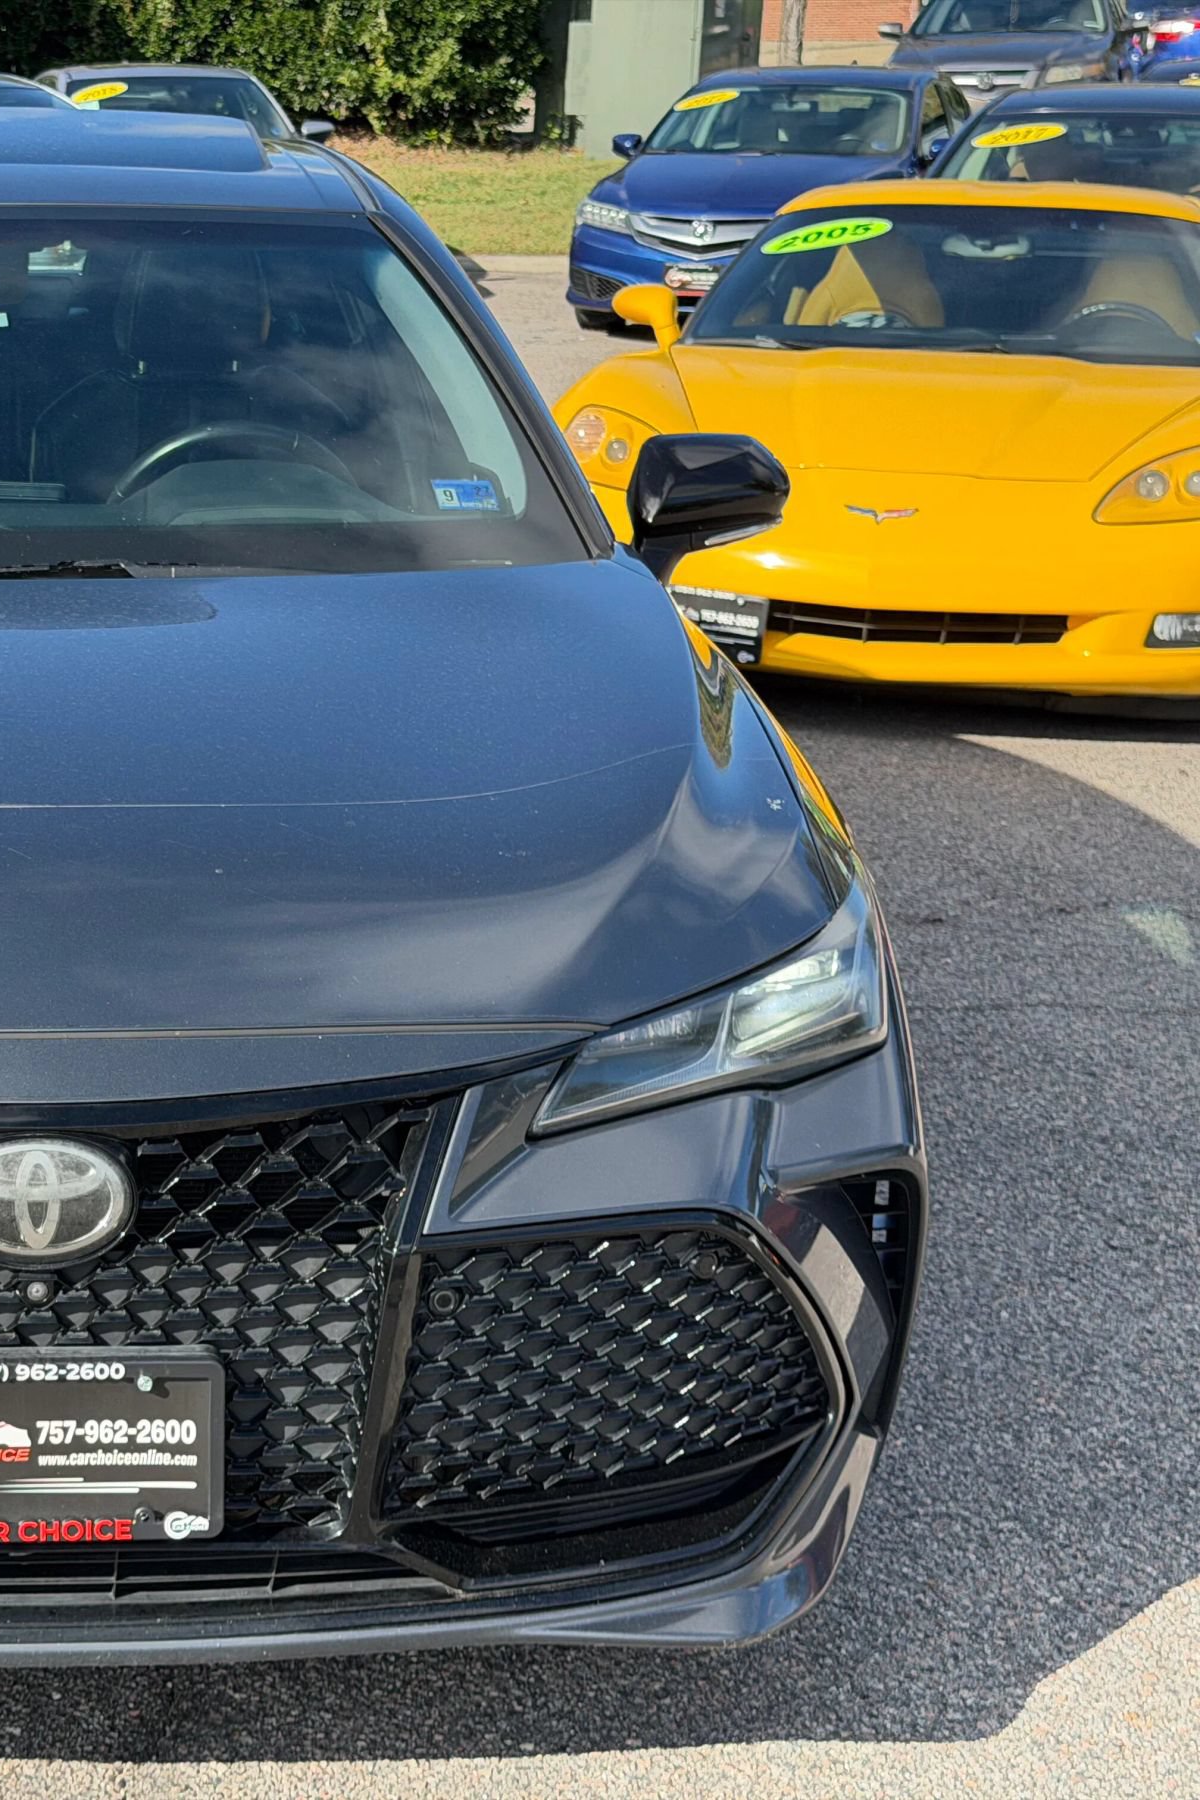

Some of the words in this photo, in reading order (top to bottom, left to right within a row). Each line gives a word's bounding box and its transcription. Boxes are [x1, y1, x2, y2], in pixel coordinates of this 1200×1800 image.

[990, 127, 1050, 145] 2017
[776, 223, 874, 252] 2005
[443, 489, 454, 502] 9
[14, 1361, 126, 1382] 962-2600
[35, 1418, 198, 1445] 757-962-2600
[37, 1449, 198, 1467] www.carchoiceonline.com
[17, 1519, 133, 1543] CHOICE
